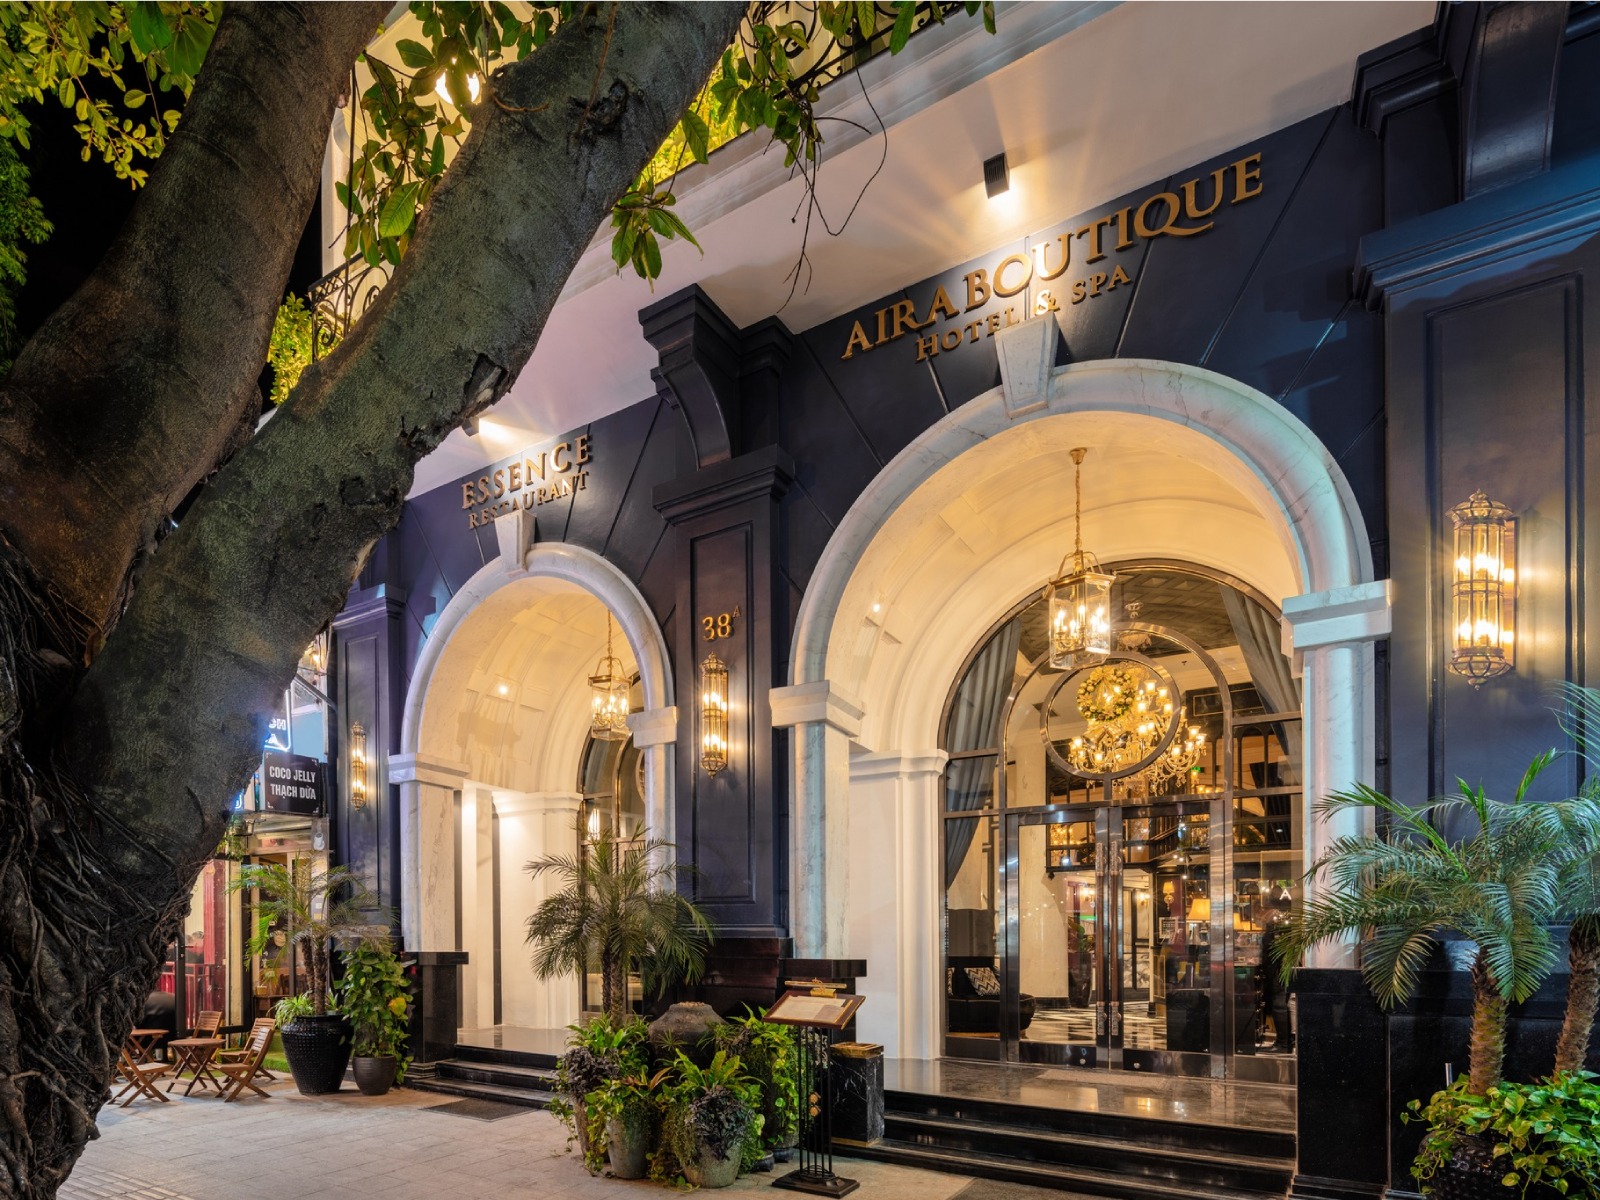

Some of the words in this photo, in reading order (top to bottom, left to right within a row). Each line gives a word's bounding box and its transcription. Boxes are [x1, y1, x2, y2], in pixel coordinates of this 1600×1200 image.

[916, 307, 1020, 363] HOTEL
[1033, 289, 1060, 316] &
[1071, 264, 1133, 305] SPA
[461, 434, 592, 510] ESSENCE
[469, 471, 589, 529] RESTAURANT
[269, 766, 291, 780] COCO
[293, 769, 316, 783] JELLY
[270, 784, 297, 799] THẠCH
[300, 785, 316, 800] DỪA
